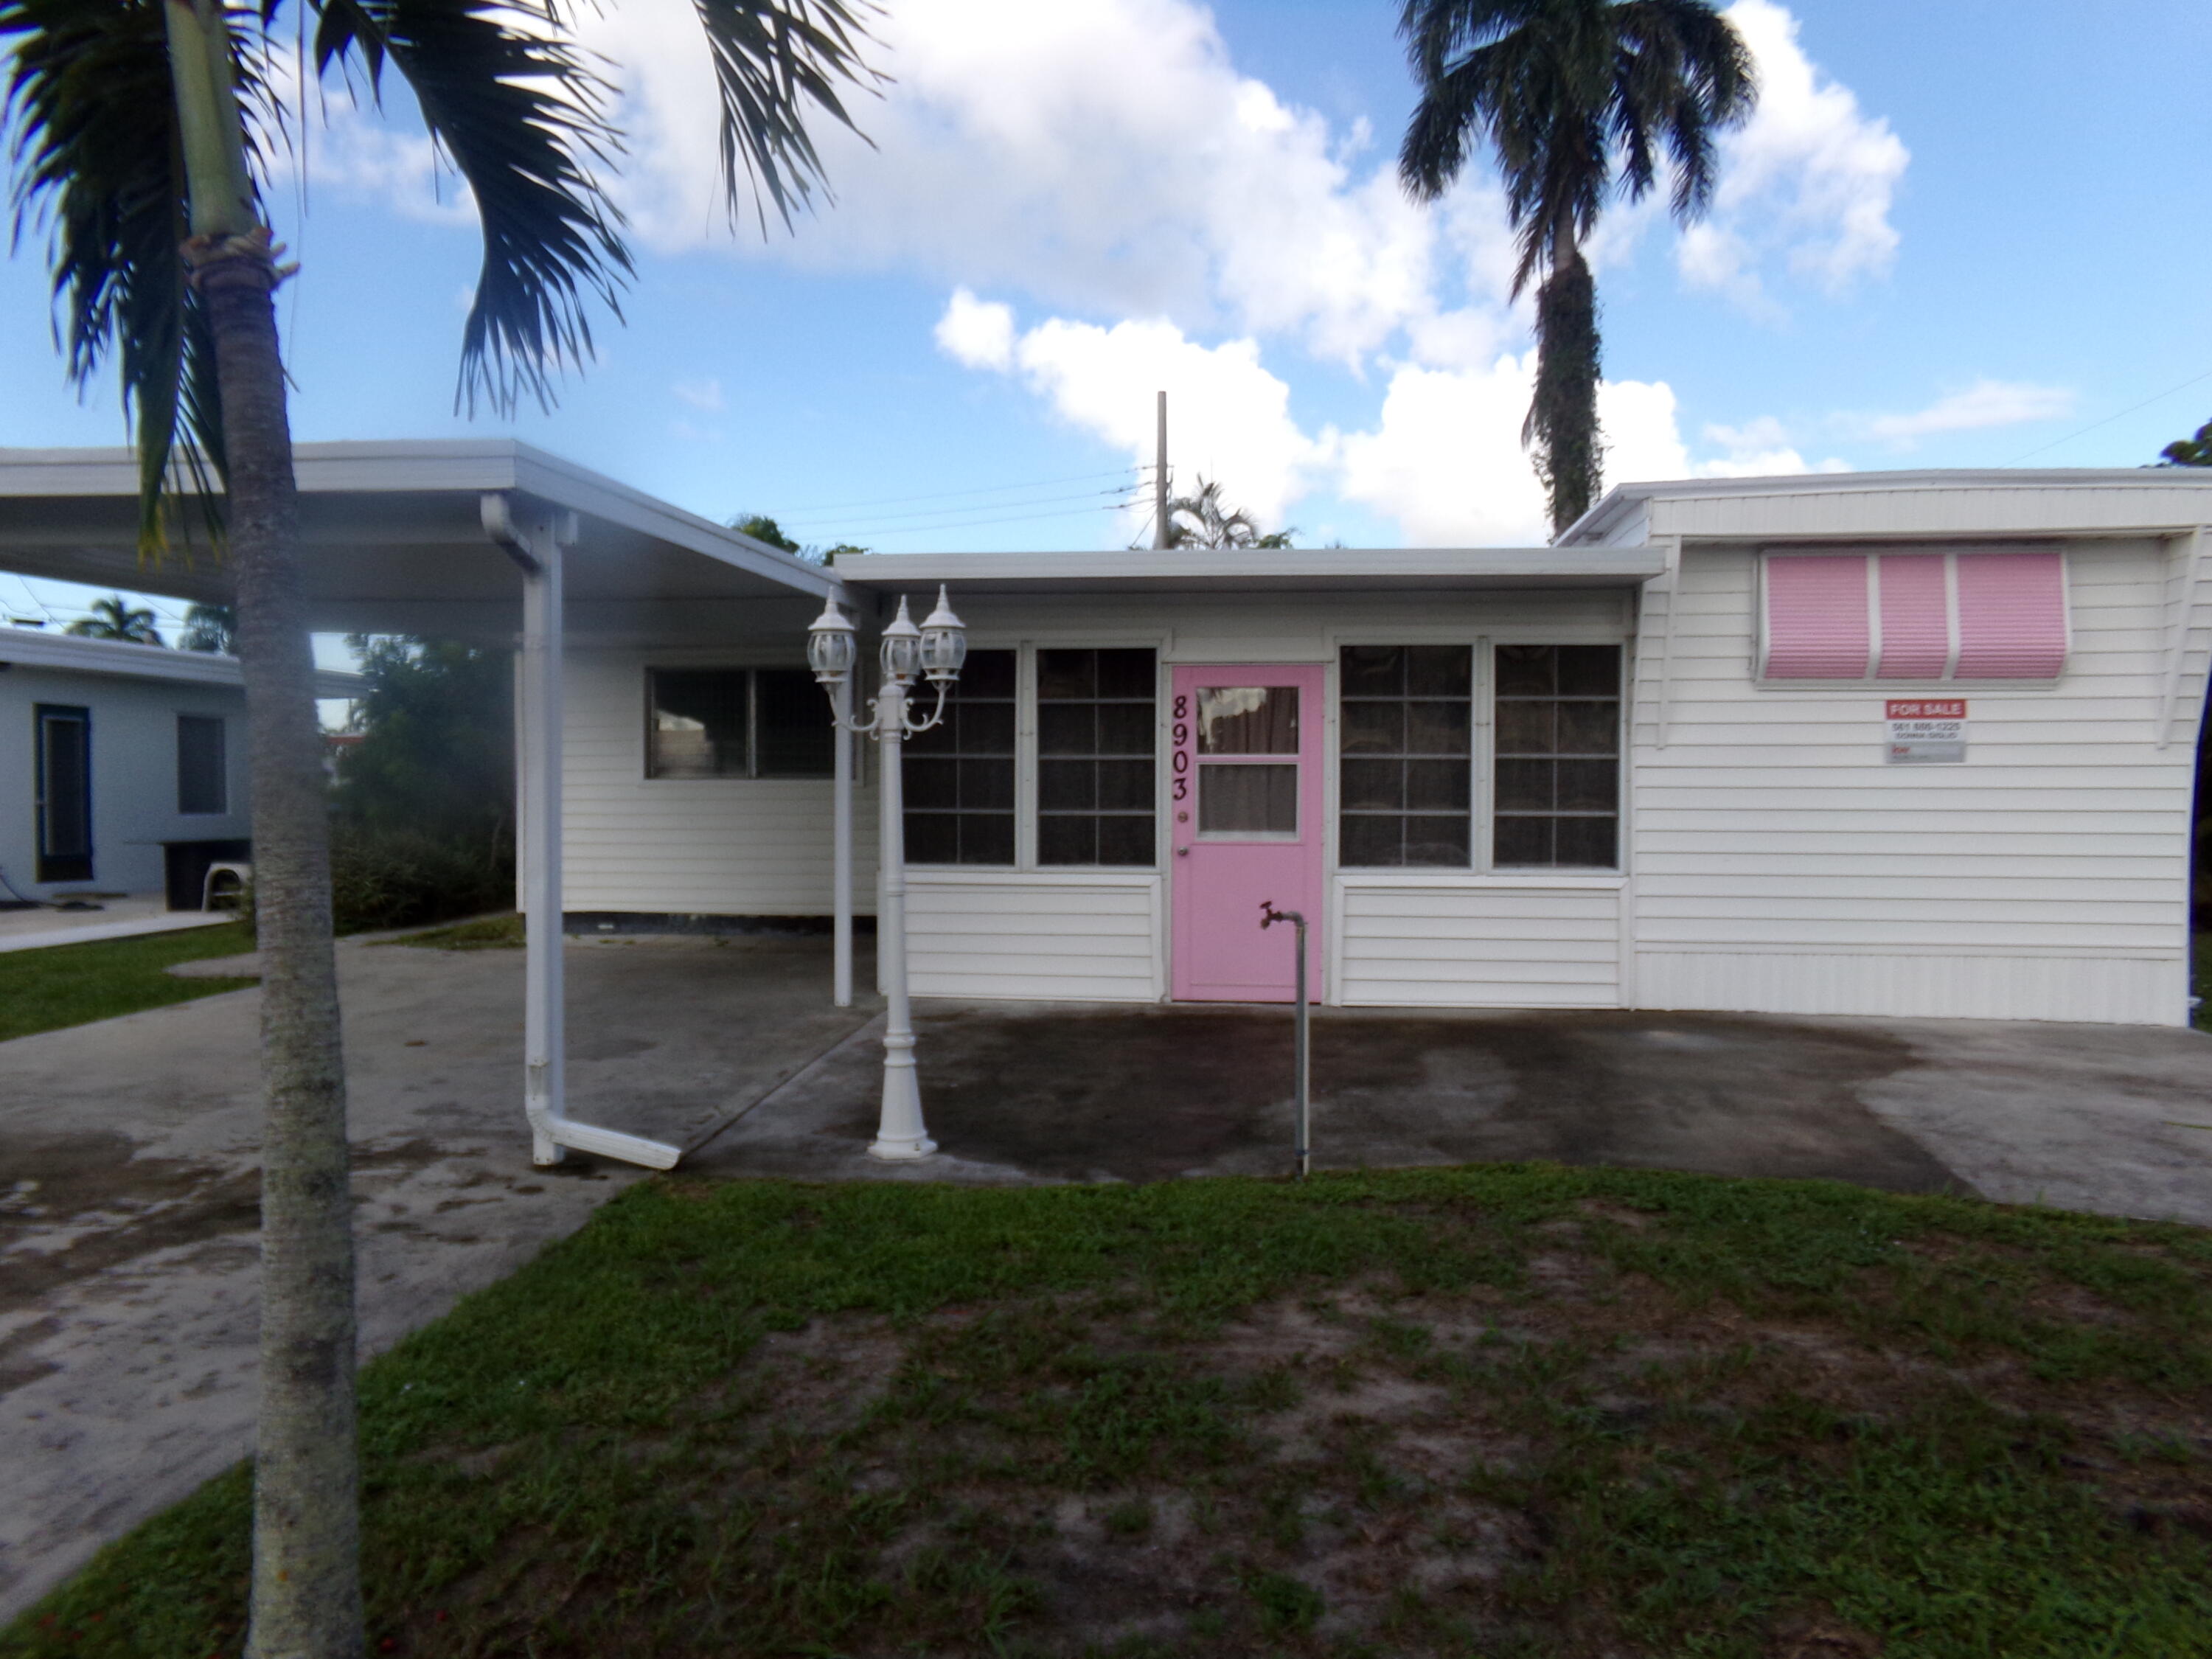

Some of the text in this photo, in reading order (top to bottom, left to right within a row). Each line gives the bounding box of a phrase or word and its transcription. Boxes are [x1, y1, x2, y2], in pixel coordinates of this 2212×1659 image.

[1891, 703, 1962, 715] FOR SALE
[1173, 695, 1188, 801] 8903
